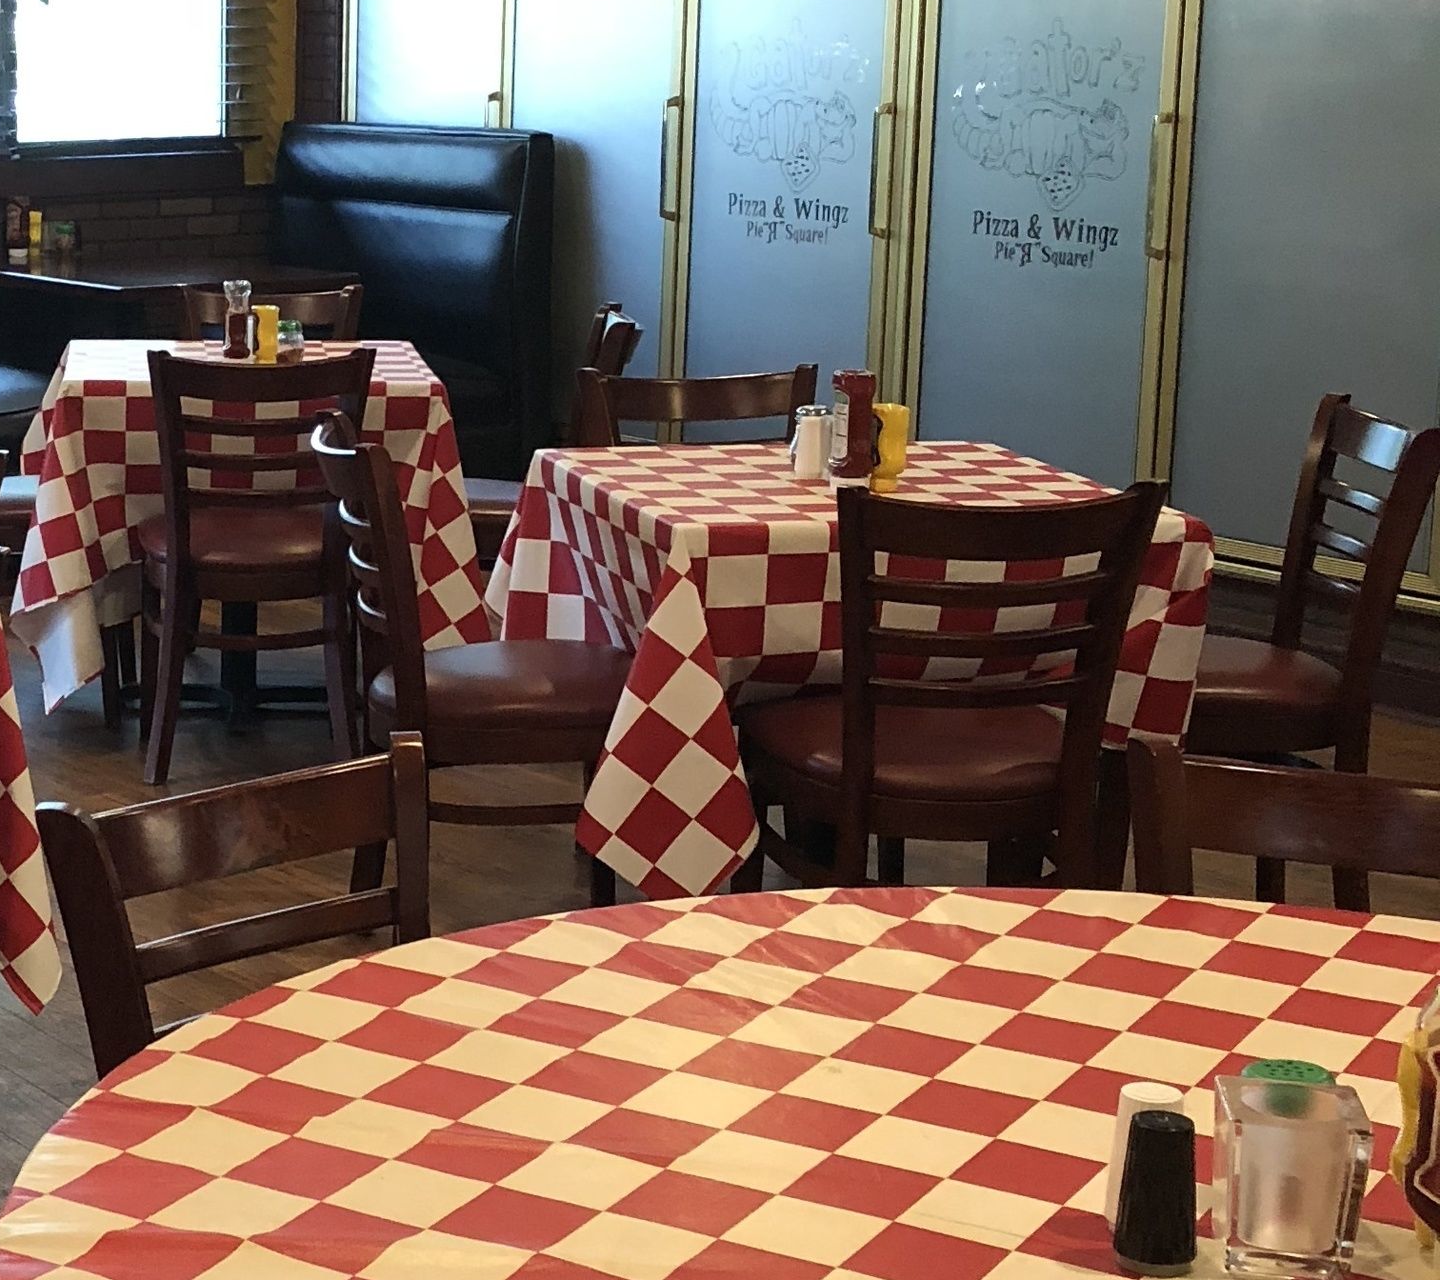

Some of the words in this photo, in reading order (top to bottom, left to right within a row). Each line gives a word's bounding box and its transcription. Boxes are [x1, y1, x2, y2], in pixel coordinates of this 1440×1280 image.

[728, 192, 766, 218] Pizza
[773, 195, 785, 219] &
[793, 197, 849, 230] Wingz
[746, 220, 764, 238] Pie
[972, 210, 1019, 238] Pizza
[1027, 213, 1042, 240] &
[1052, 216, 1119, 252] Wingz
[994, 241, 1016, 260] Pie
[1041, 244, 1094, 269] Square!
